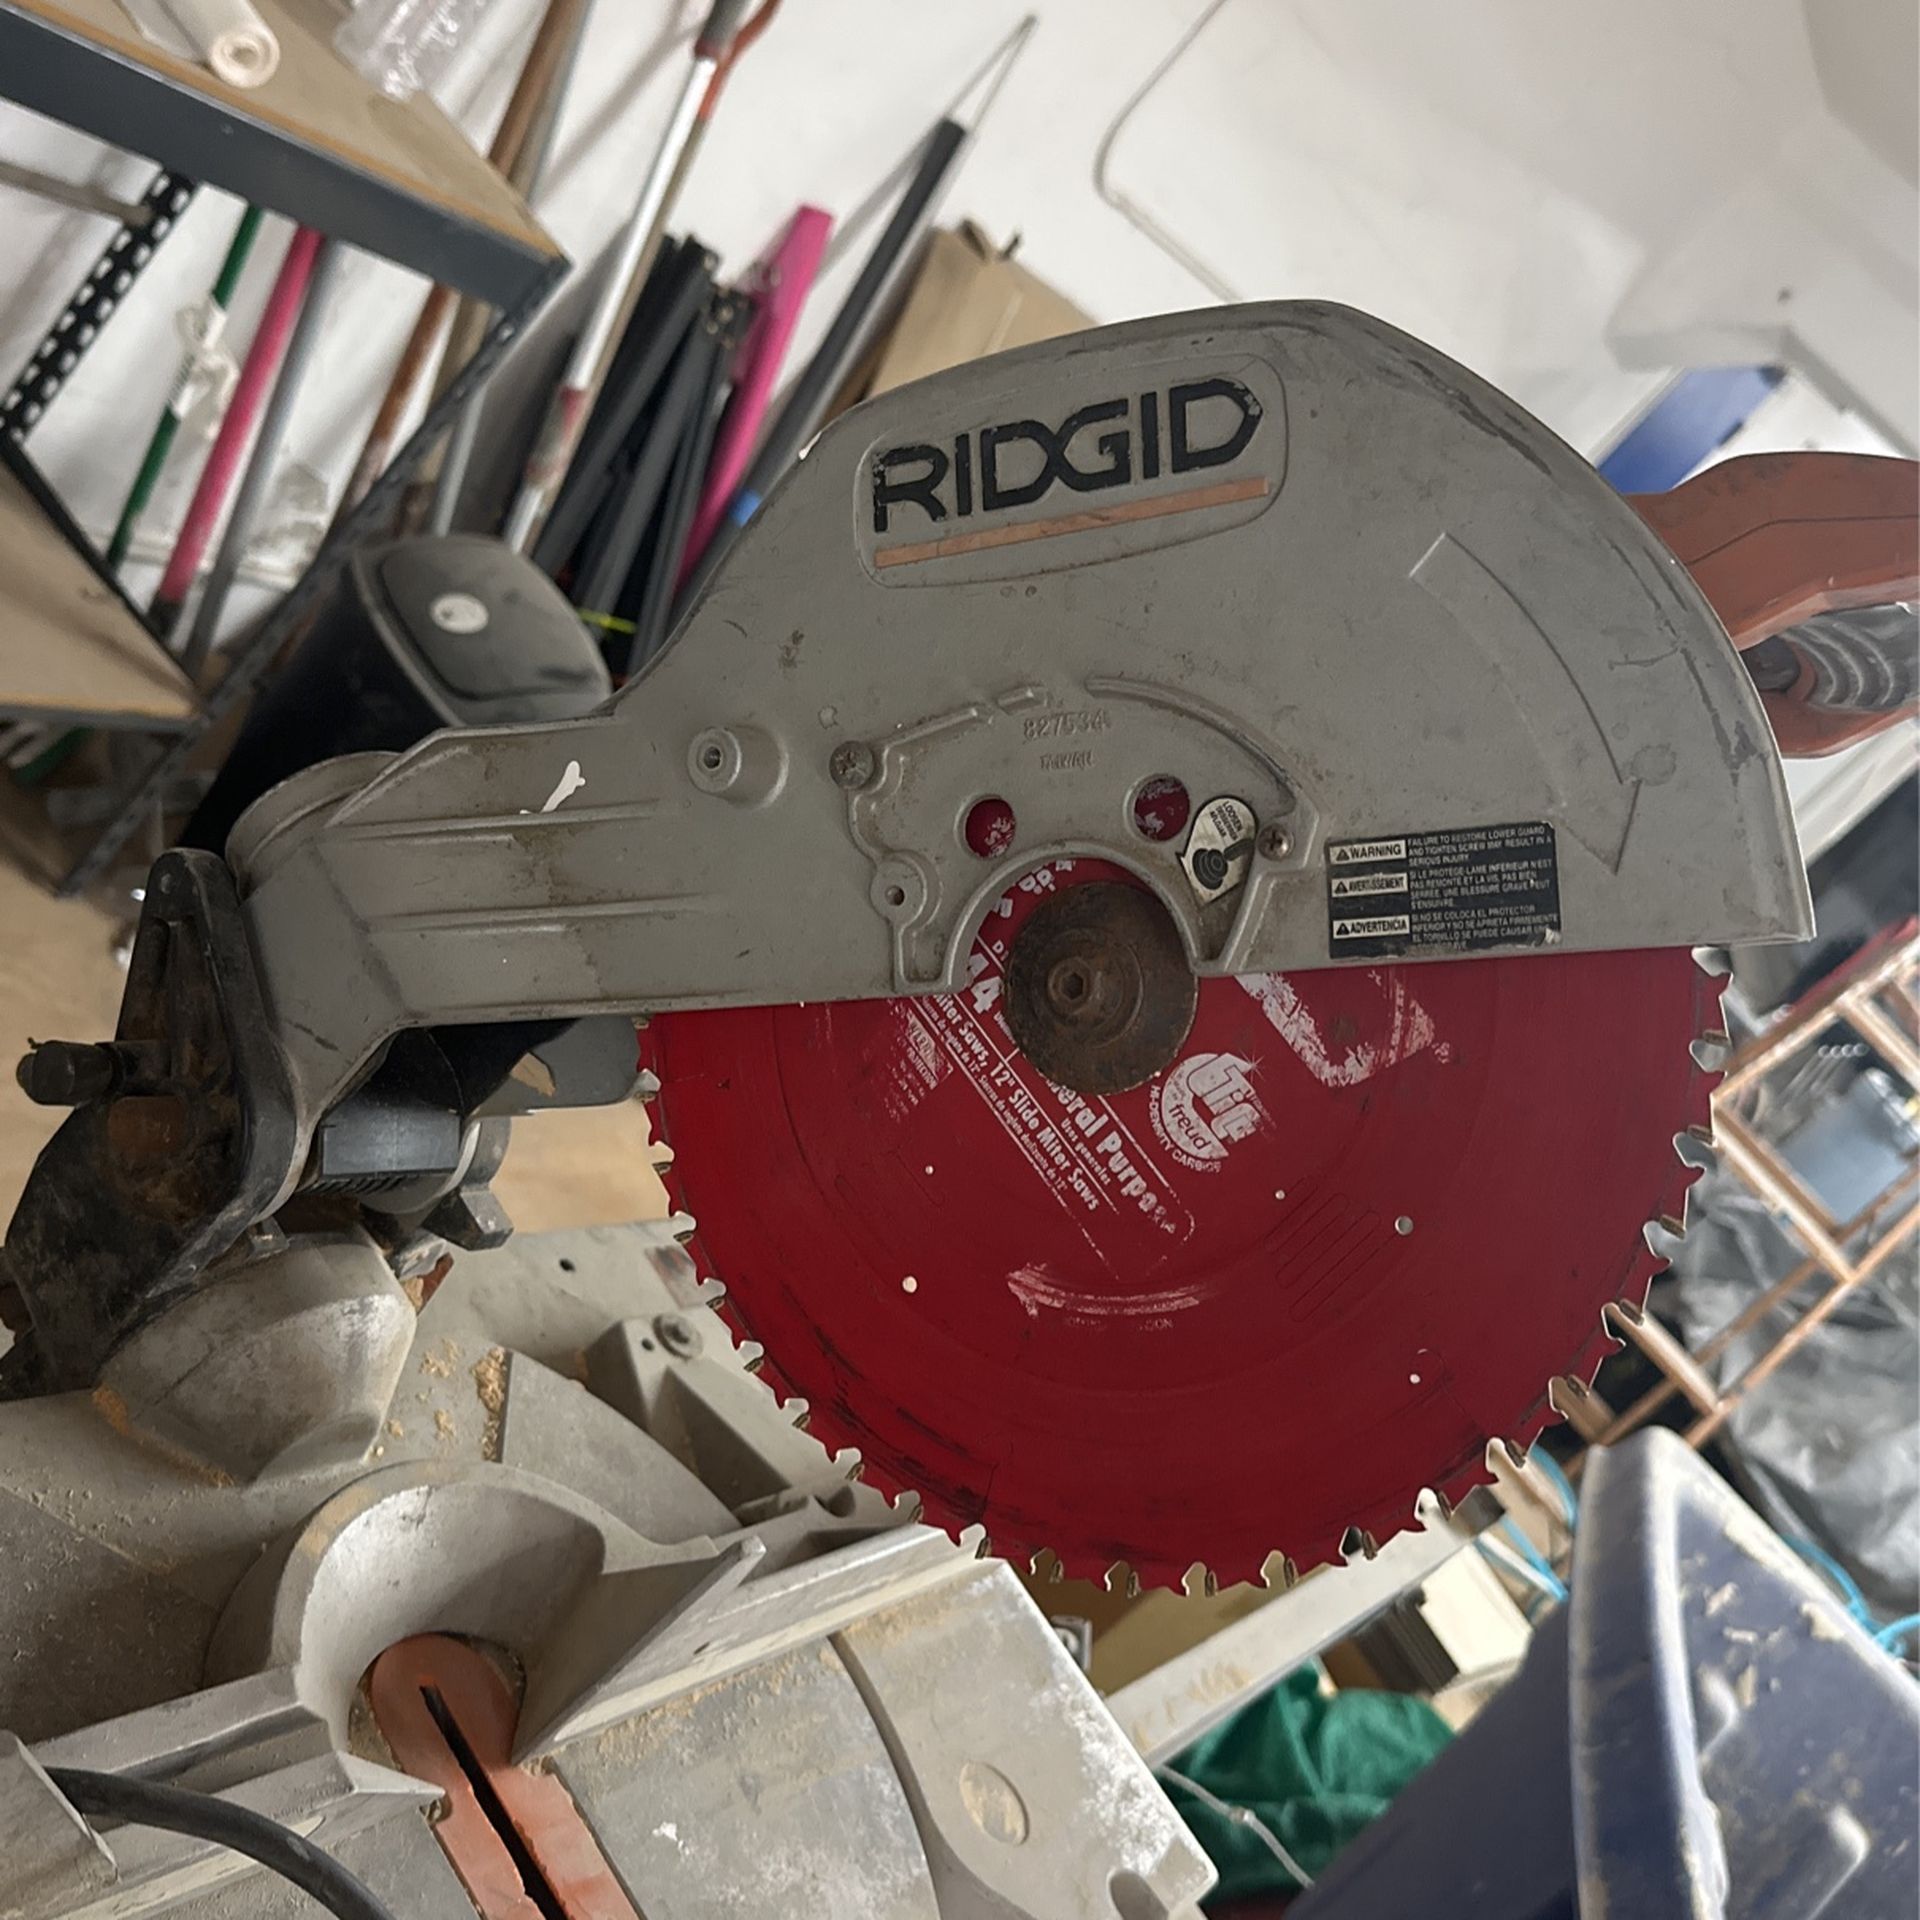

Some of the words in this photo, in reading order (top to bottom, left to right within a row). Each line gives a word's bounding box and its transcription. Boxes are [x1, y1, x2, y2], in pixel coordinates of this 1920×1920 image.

[873, 379, 1263, 533] RIDGID
[1222, 800, 1244, 831] LOOSEN
[1349, 843, 1401, 858] WARNING
[1407, 835, 1438, 846] FAILURE
[1440, 834, 1449, 844] TO
[1487, 828, 1515, 839] LOWER
[1408, 847, 1424, 856] AND
[1504, 836, 1534, 847] RESULT
[1536, 836, 1544, 844] IN
[1350, 918, 1406, 933] ADVERTENCIA
[1444, 909, 1476, 920] COLOCA
[1488, 904, 1535, 916] PROTECTOR
[954, 1019, 997, 1069] Saws,
[987, 1061, 1016, 1093] 12"
[1006, 1086, 1045, 1132] Slide
[1034, 1126, 1075, 1172] Miter
[1064, 1165, 1104, 1211] Saws
[976, 1073, 1001, 1102] Sierras
[994, 1097, 1008, 1111] de
[1045, 1165, 1060, 1180] de
[1167, 1102, 1212, 1151] freud
[1058, 1116, 1082, 1143] Uses
[1072, 1138, 1114, 1188] generales
[1096, 1130, 1177, 1234] Purpo
